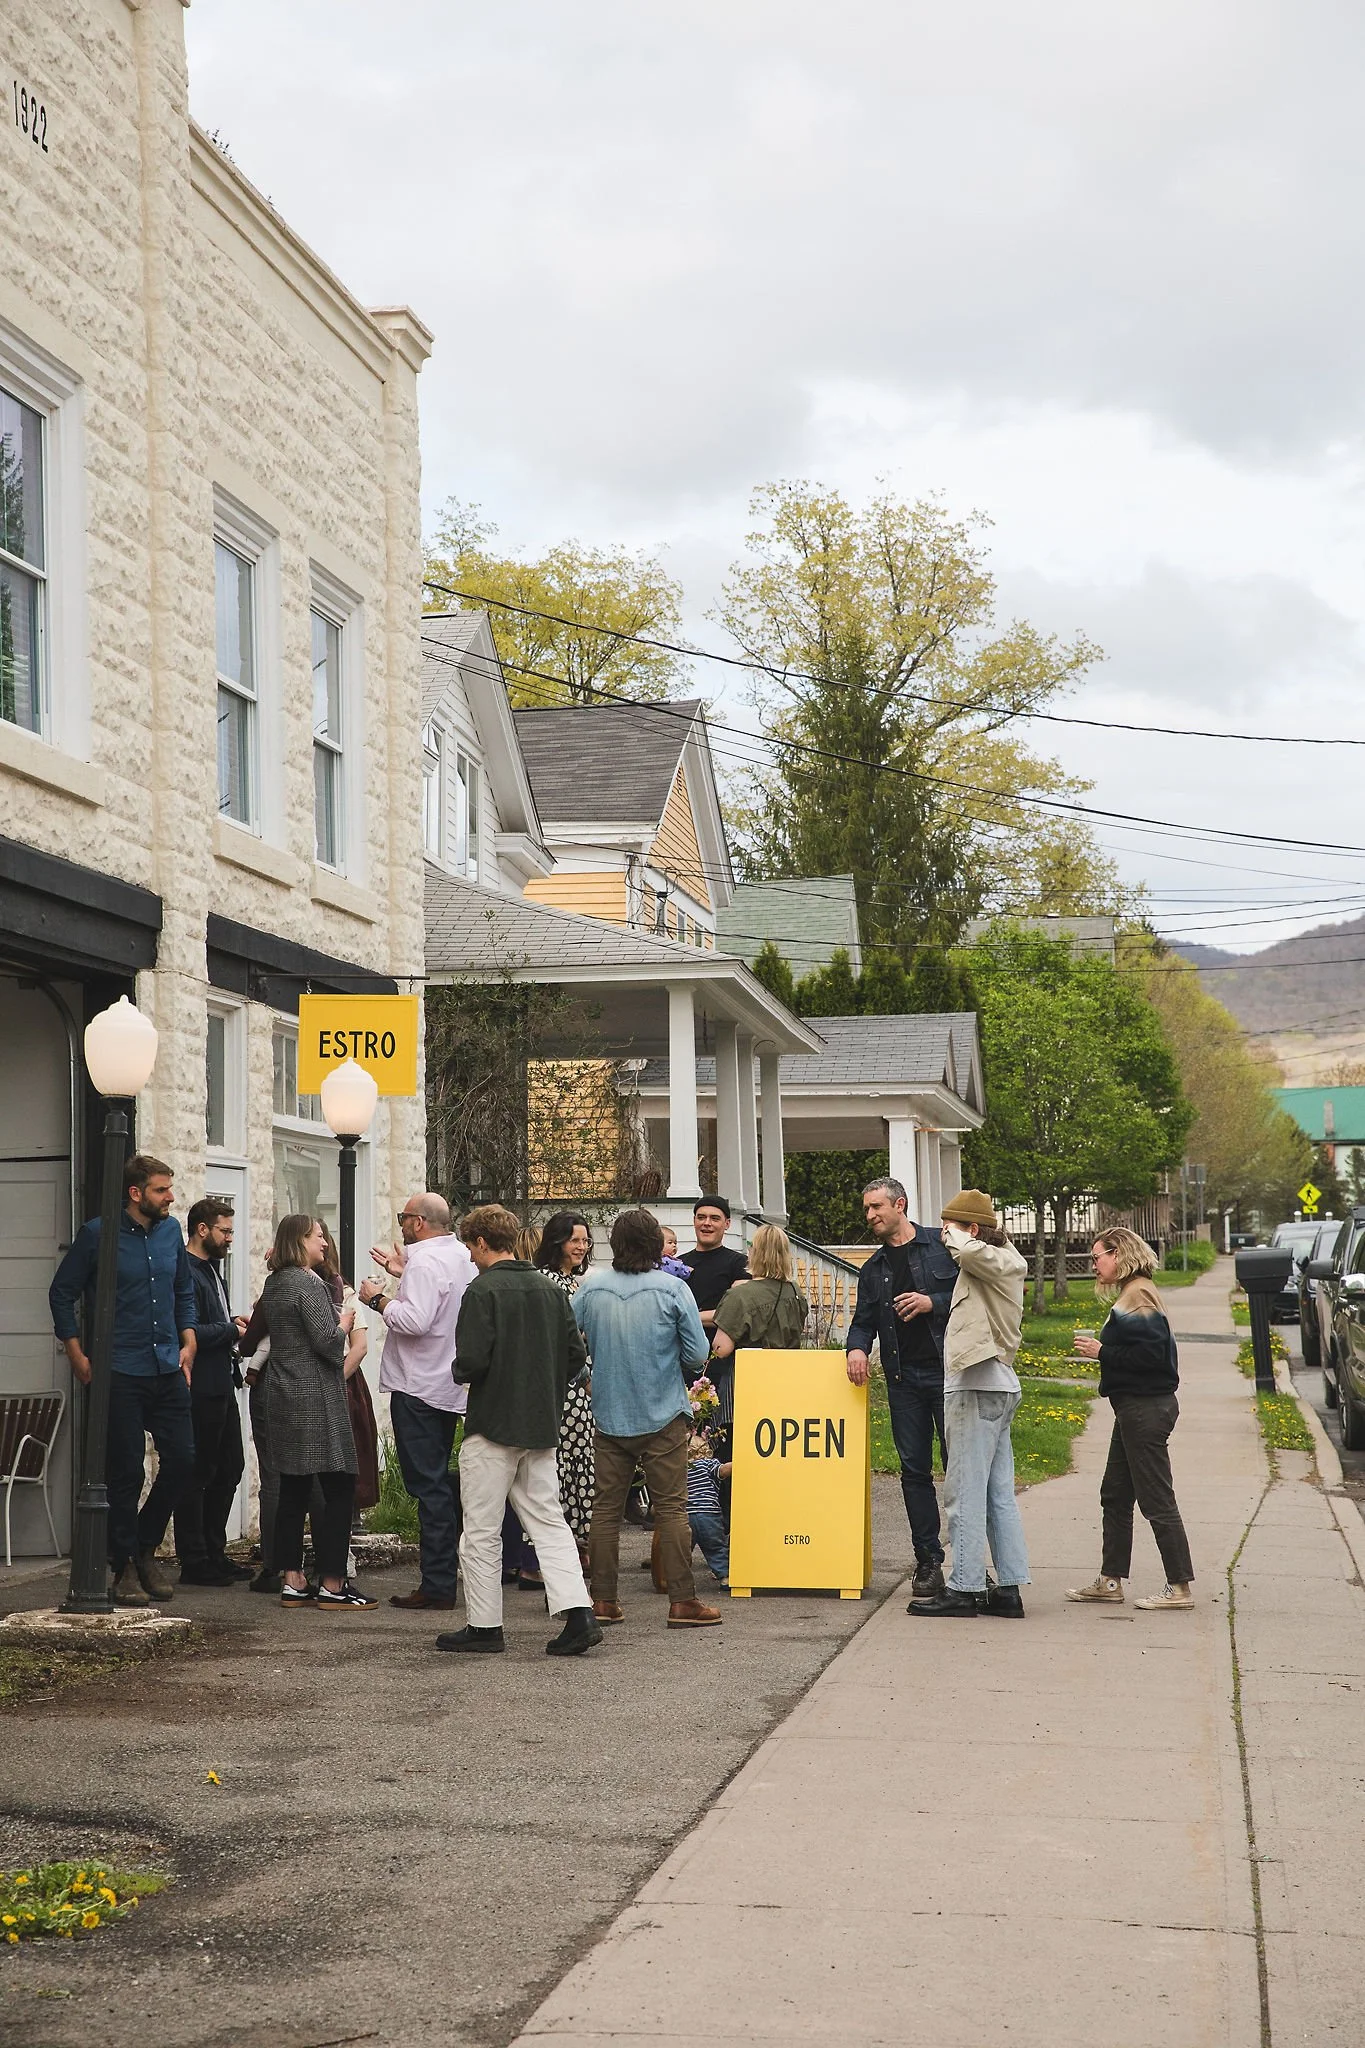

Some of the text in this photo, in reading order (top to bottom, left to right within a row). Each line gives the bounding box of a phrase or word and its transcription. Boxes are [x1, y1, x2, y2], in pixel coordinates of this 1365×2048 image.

[14, 80, 49, 153] 1922
[319, 1030, 396, 1059] ESTRO
[754, 1417, 845, 1459] OPEN
[784, 1534, 811, 1545] ESTRO
